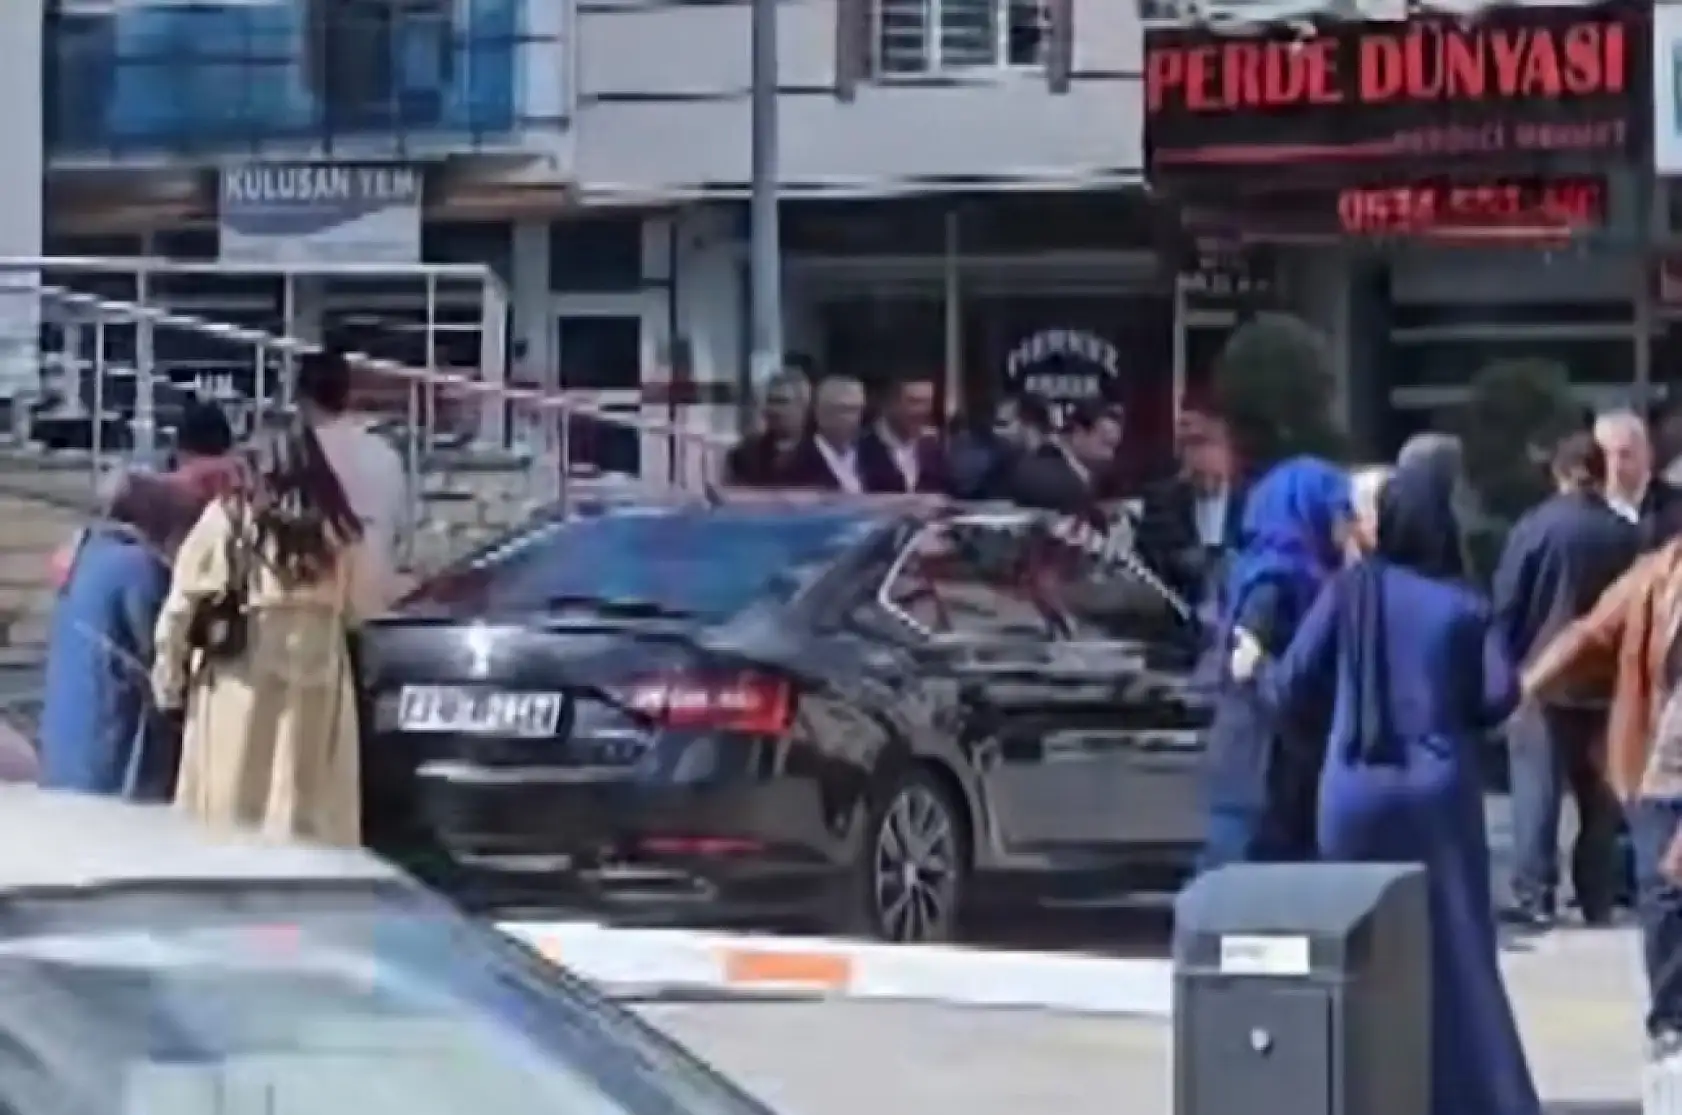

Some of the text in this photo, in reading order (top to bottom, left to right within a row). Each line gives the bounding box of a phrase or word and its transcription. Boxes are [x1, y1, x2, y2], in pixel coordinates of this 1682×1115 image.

[1147, 22, 1624, 113] PERDE DÜNYASI
[226, 168, 348, 200] KULUSAN
